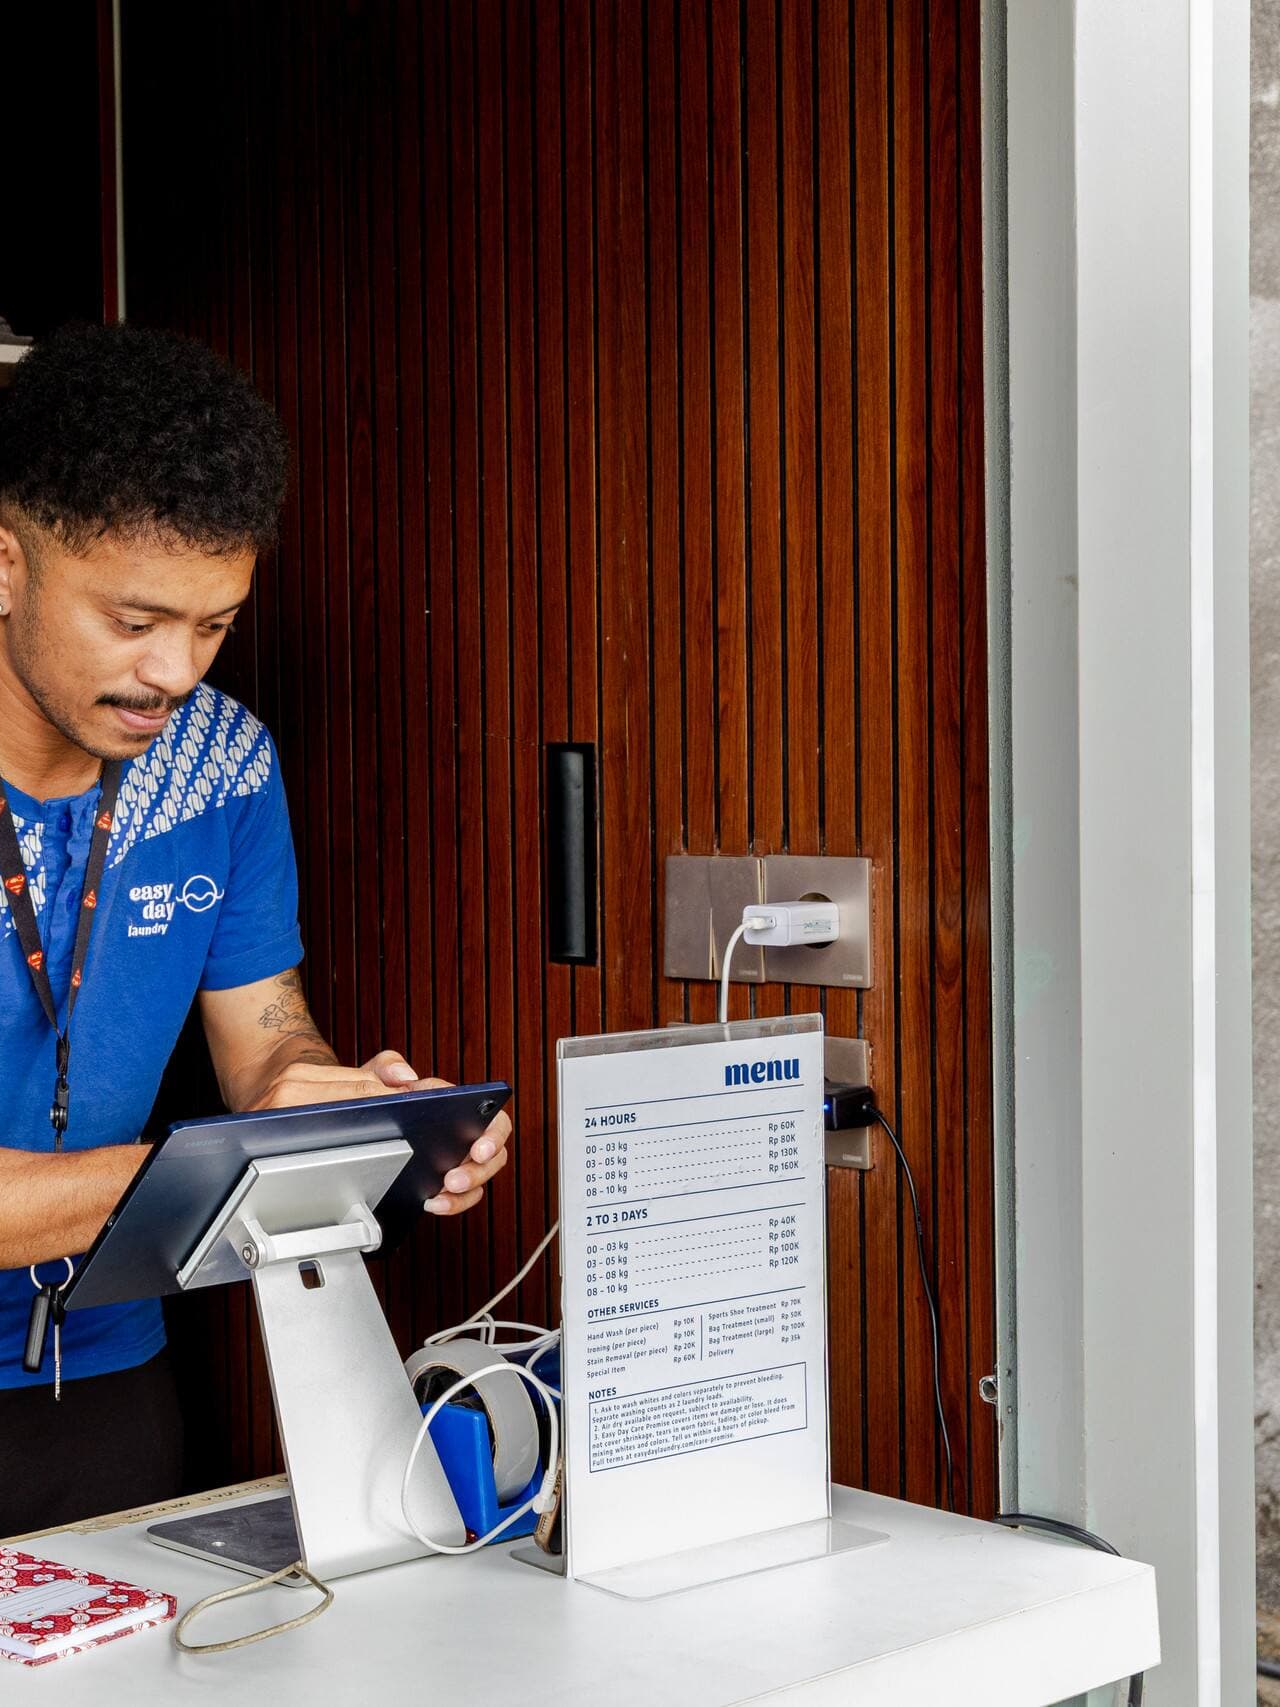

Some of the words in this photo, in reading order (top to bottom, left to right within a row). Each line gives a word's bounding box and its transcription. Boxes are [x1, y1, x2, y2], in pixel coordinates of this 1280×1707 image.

[129, 883, 174, 902] easy
[142, 900, 175, 920] day
[128, 922, 168, 937] laundry
[725, 1058, 800, 1086] menu
[584, 1117, 596, 1127] 24
[600, 1112, 636, 1126] HOURS
[585, 1145, 596, 1154] 00
[605, 1142, 615, 1151] 03
[618, 1141, 627, 1151] kg
[768, 1122, 778, 1132] Rp
[780, 1120, 795, 1129] 60K
[585, 1159, 595, 1168] 03
[604, 1156, 614, 1166] 05
[617, 1155, 626, 1166] kg
[768, 1136, 778, 1146] Rp
[780, 1133, 795, 1143] 80K
[585, 1173, 596, 1182] 05
[604, 1170, 615, 1179] 08
[618, 1169, 627, 1179] kg
[768, 1150, 778, 1159] Rp
[780, 1147, 798, 1156] 130K
[586, 1187, 597, 1196] 08
[606, 1185, 614, 1193] 10
[617, 1184, 627, 1194] kg
[768, 1163, 778, 1173] Rp
[780, 1160, 798, 1169] 160K
[586, 1216, 592, 1226] 2
[595, 1214, 609, 1224] TO
[612, 1212, 617, 1222] 3
[621, 1208, 647, 1221] DAYS
[586, 1244, 597, 1254] 00
[606, 1242, 617, 1251] 03
[618, 1240, 628, 1250] kg
[768, 1218, 778, 1227] Rp
[780, 1215, 795, 1224] 40K
[586, 1259, 596, 1268] 03
[605, 1256, 615, 1265] 05
[617, 1255, 627, 1265] kg
[768, 1232, 778, 1241] Rp
[780, 1228, 795, 1238] 60K
[586, 1273, 596, 1283] 05
[605, 1270, 616, 1279] 08
[618, 1269, 628, 1279] kg
[768, 1244, 778, 1254] Rp
[780, 1241, 799, 1251] 100K
[586, 1287, 597, 1296] 08
[606, 1284, 615, 1293] 10
[617, 1283, 627, 1293] kg
[769, 1259, 779, 1268] Rp
[781, 1255, 798, 1265] 120K
[587, 1306, 616, 1318] OTHER
[619, 1298, 658, 1311] SERVICES
[588, 1386, 616, 1399] NOTES
